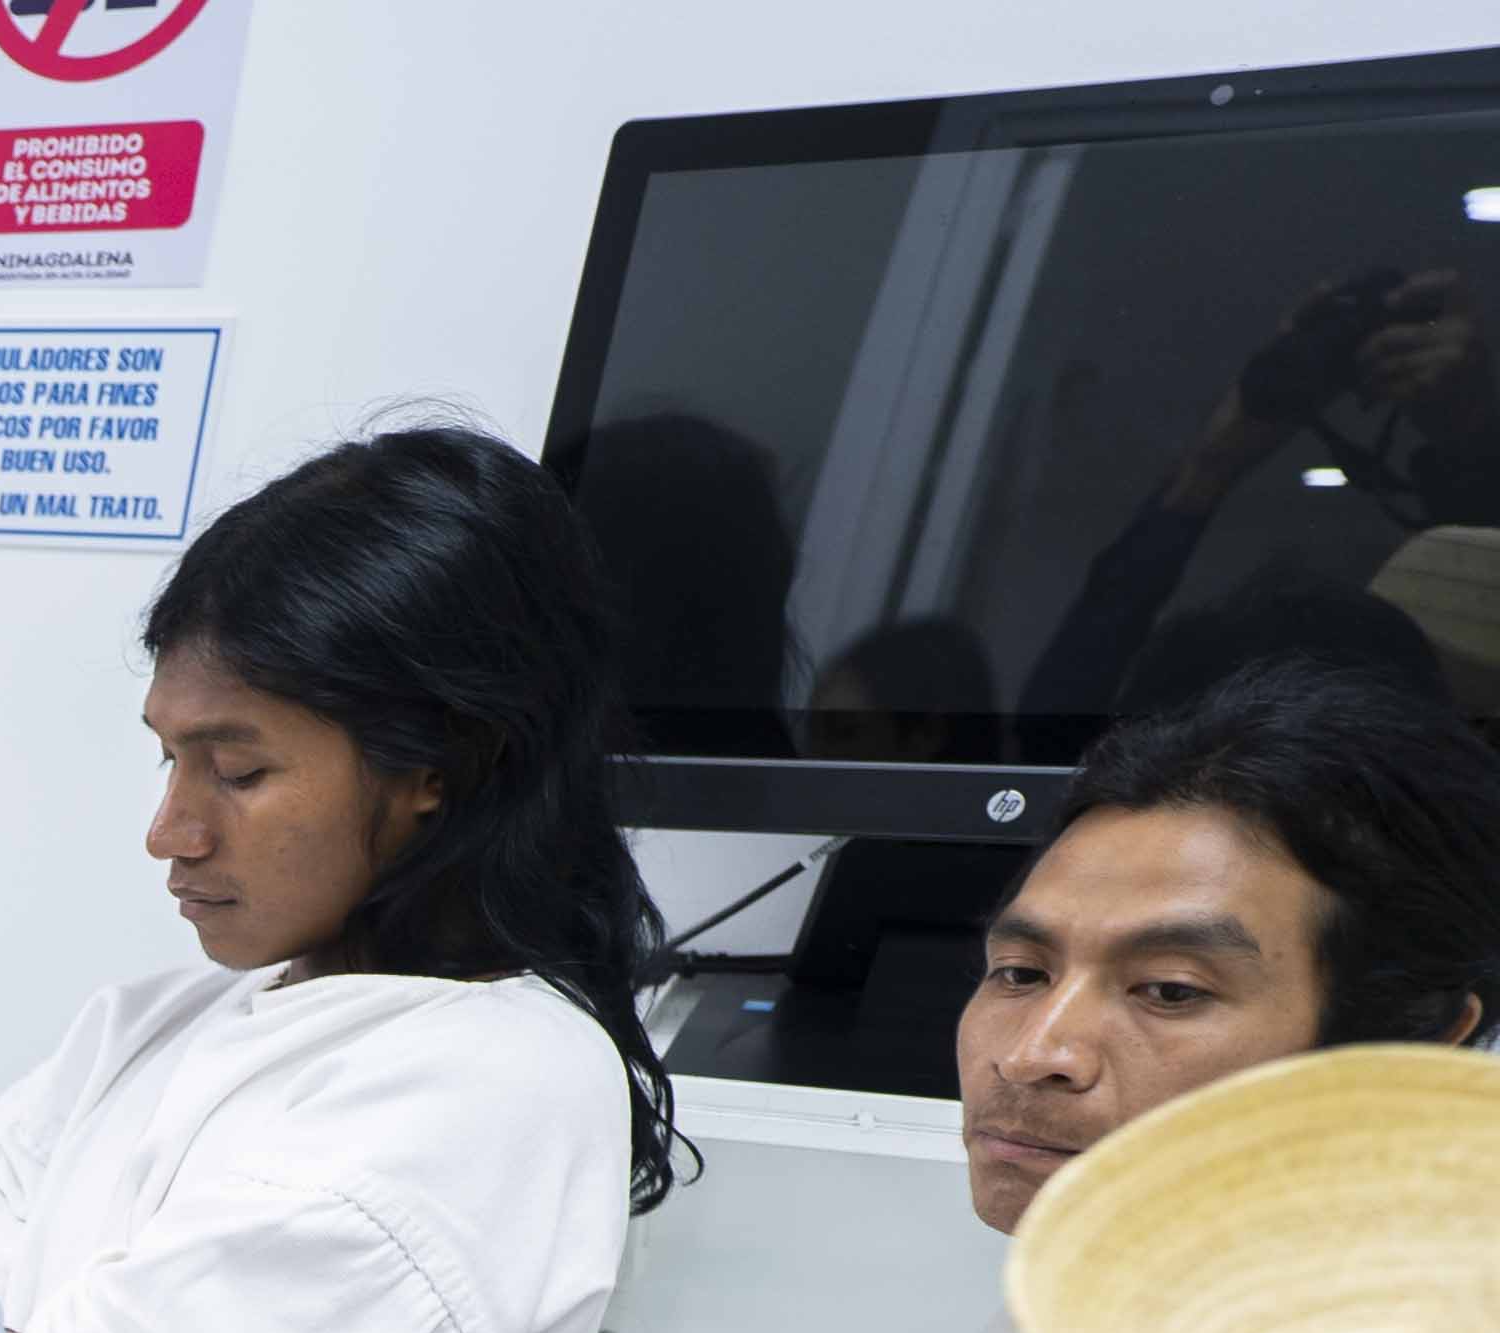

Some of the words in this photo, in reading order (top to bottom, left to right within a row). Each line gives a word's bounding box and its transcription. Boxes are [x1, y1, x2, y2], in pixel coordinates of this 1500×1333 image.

[12, 133, 144, 158] PROHIBIDO
[3, 160, 28, 181] EL
[30, 155, 147, 180] CONSUMO
[24, 178, 151, 203] ALIMENTOS
[14, 205, 30, 225] Y
[31, 202, 127, 225] BEBIDAS
[117, 347, 163, 372] SON
[32, 382, 89, 406] PARA
[97, 382, 158, 406] FINES
[38, 415, 80, 440] POR
[87, 415, 159, 441] FAVOR
[1, 449, 55, 473] BUEN
[62, 450, 111, 475] USO.
[0, 490, 28, 515] UN
[34, 492, 78, 517] MAL
[88, 494, 163, 521] TRATO.
